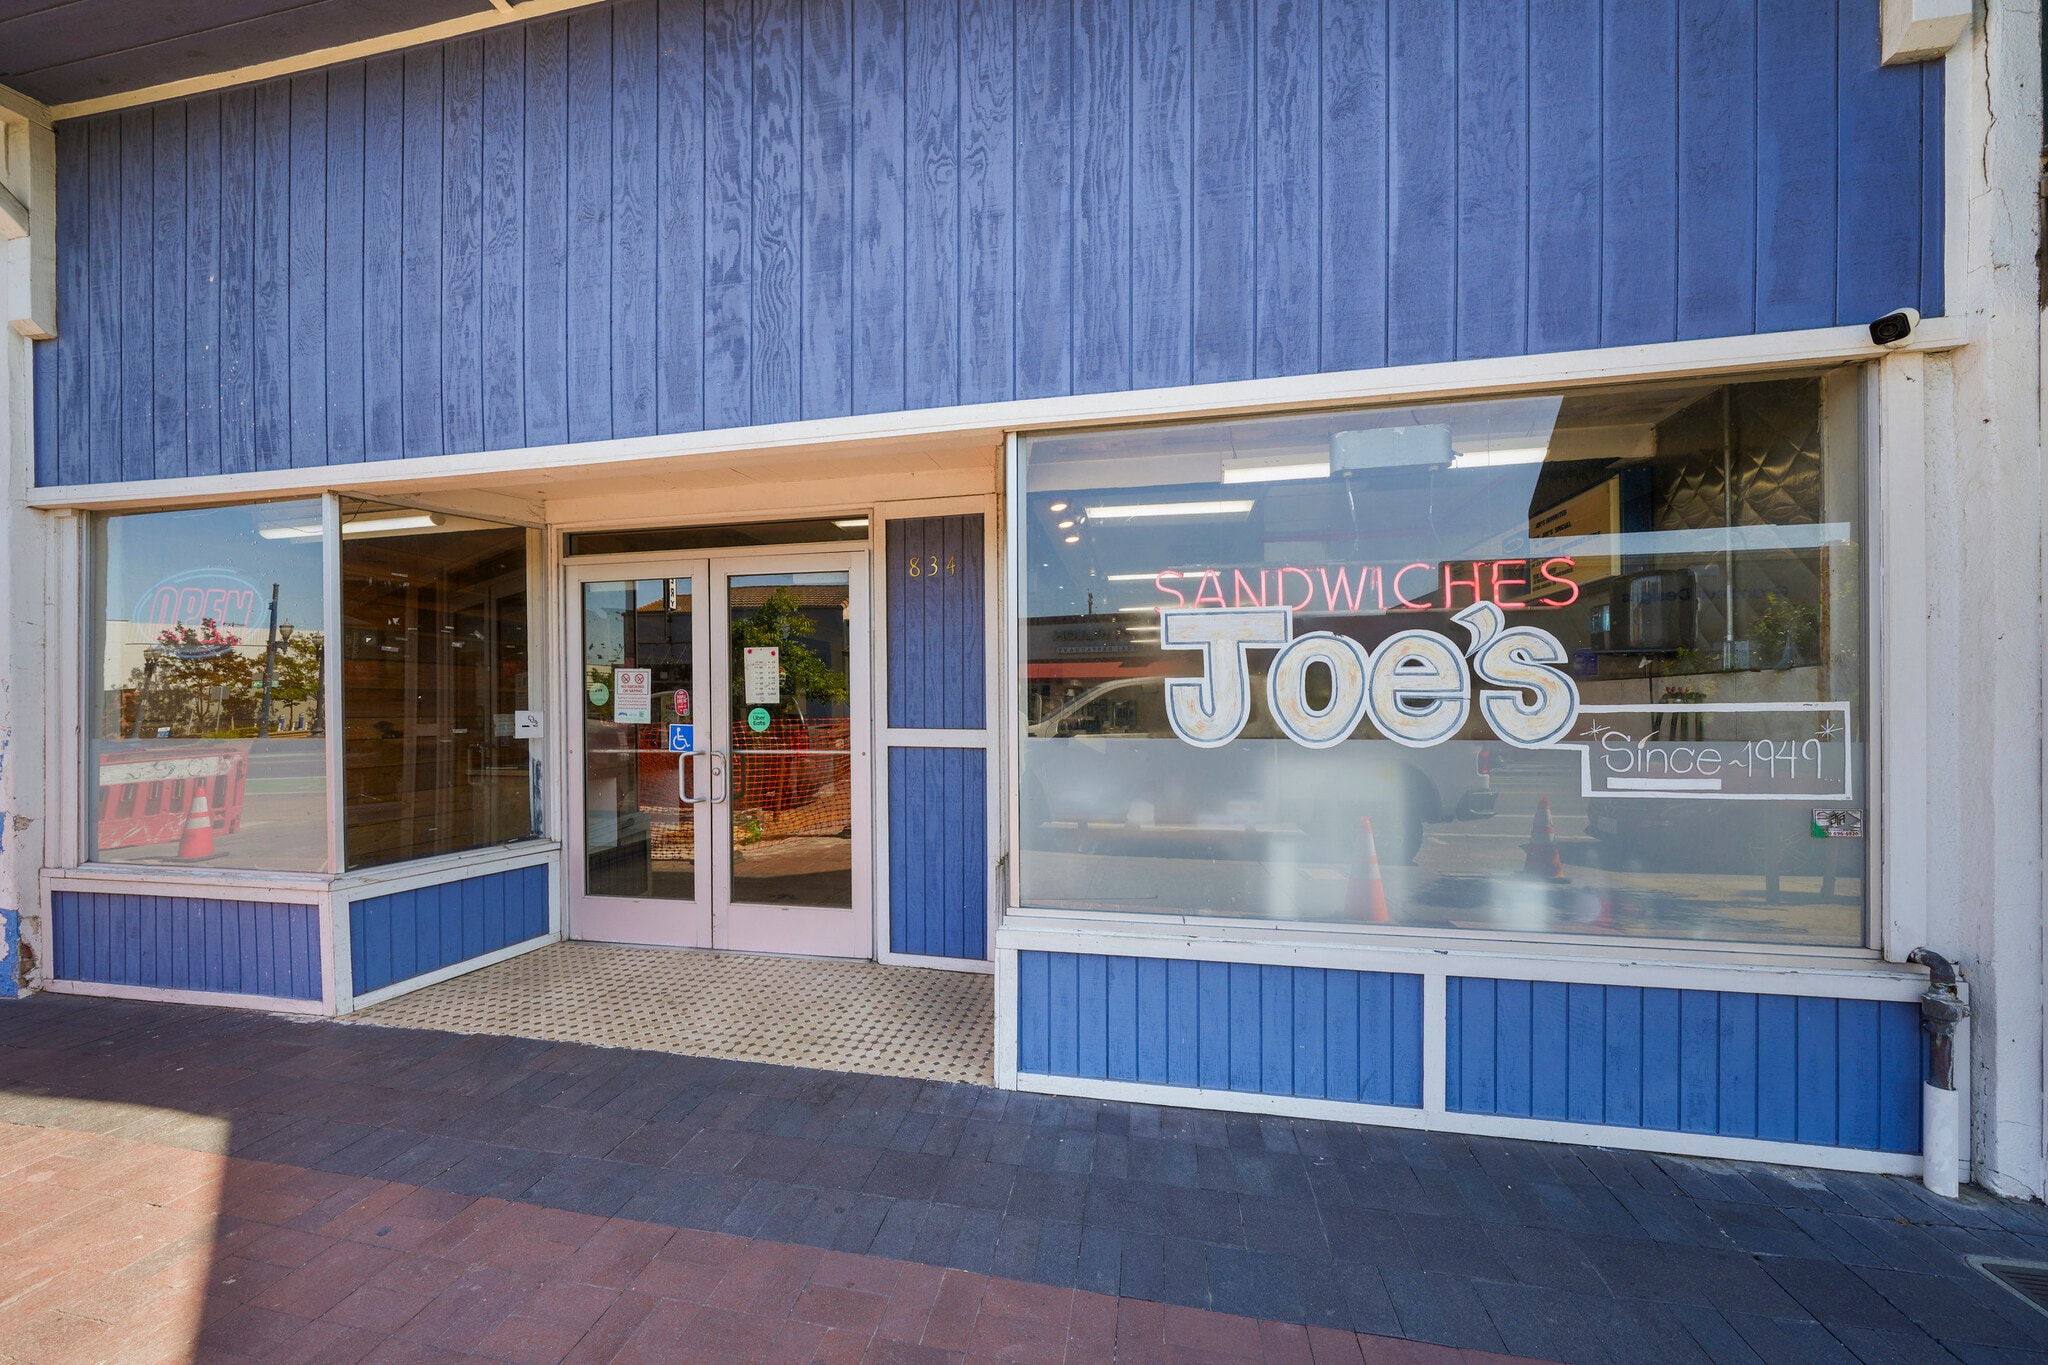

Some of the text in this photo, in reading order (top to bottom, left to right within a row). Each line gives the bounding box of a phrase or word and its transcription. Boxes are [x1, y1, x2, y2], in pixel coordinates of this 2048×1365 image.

[909, 555, 956, 577] 834
[1154, 556, 1580, 614] SANDWICHES
[148, 586, 254, 646] OPEN
[1160, 600, 1580, 749] Joe's
[1600, 731, 1722, 776] Since
